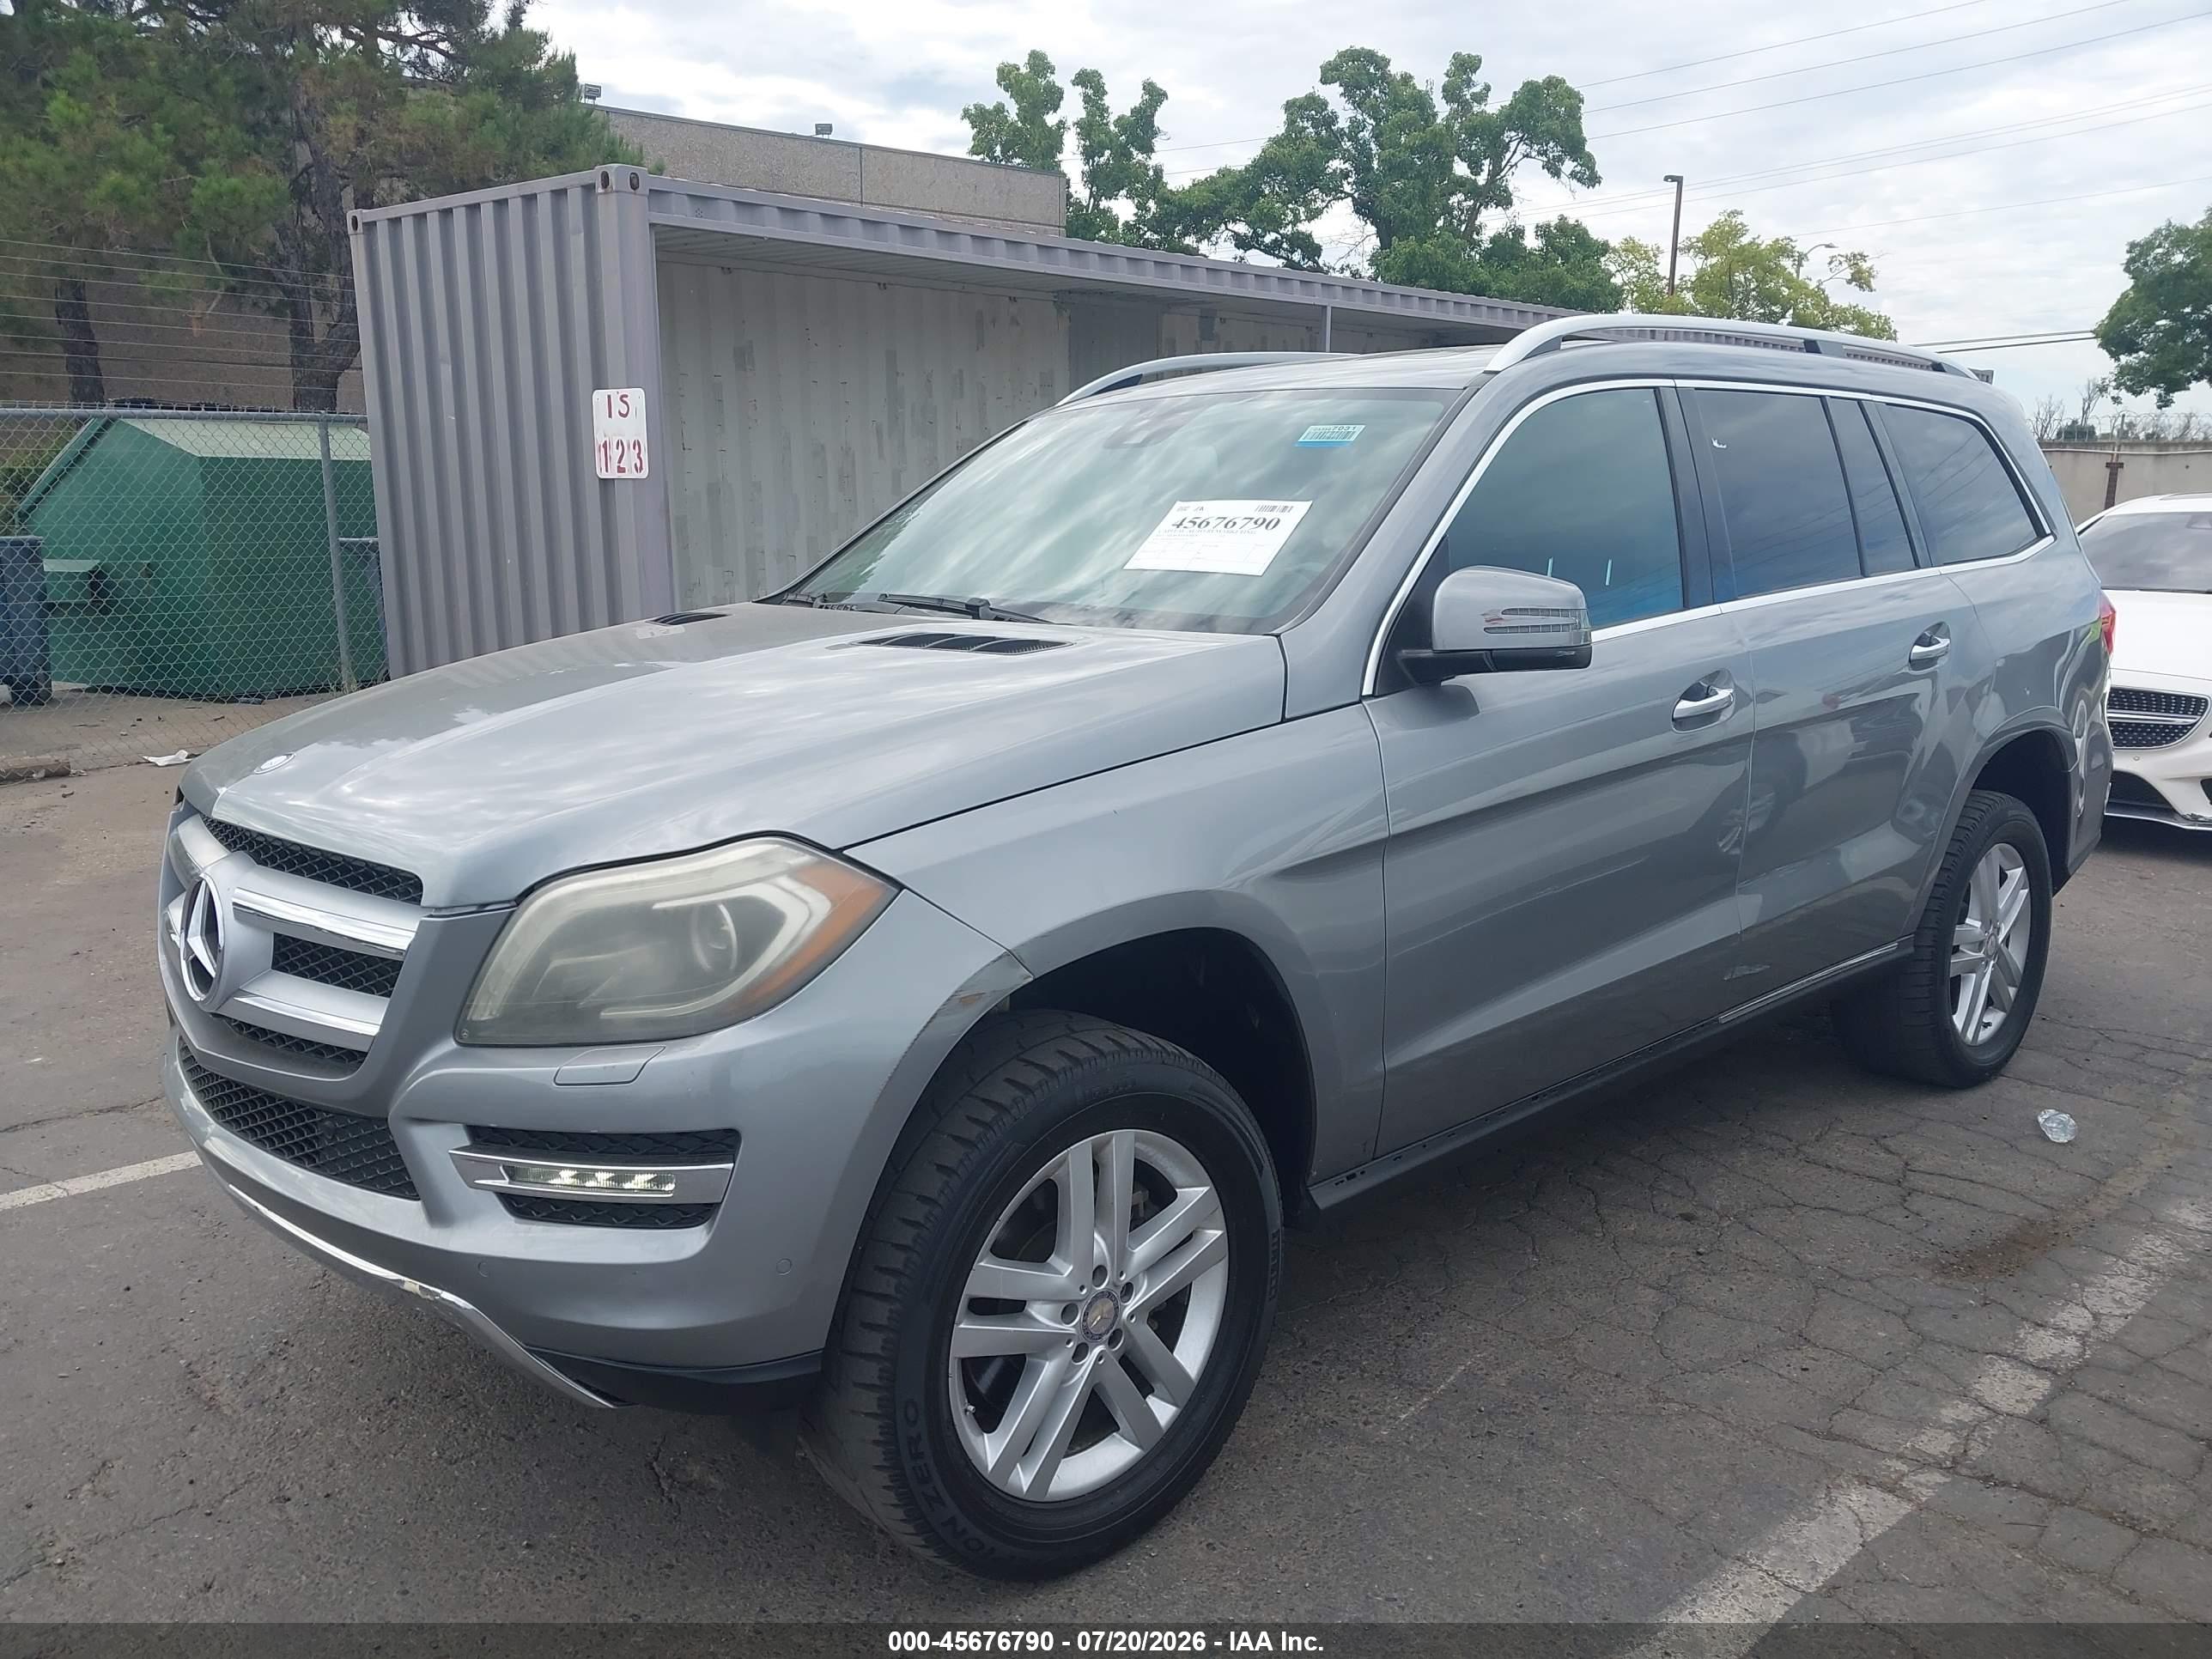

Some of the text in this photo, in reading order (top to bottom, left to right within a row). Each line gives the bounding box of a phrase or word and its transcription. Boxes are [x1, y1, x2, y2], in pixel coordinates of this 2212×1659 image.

[602, 439, 644, 473] 123
[1171, 516, 1280, 531] 45676790
[903, 1400, 946, 1512] ZERO
